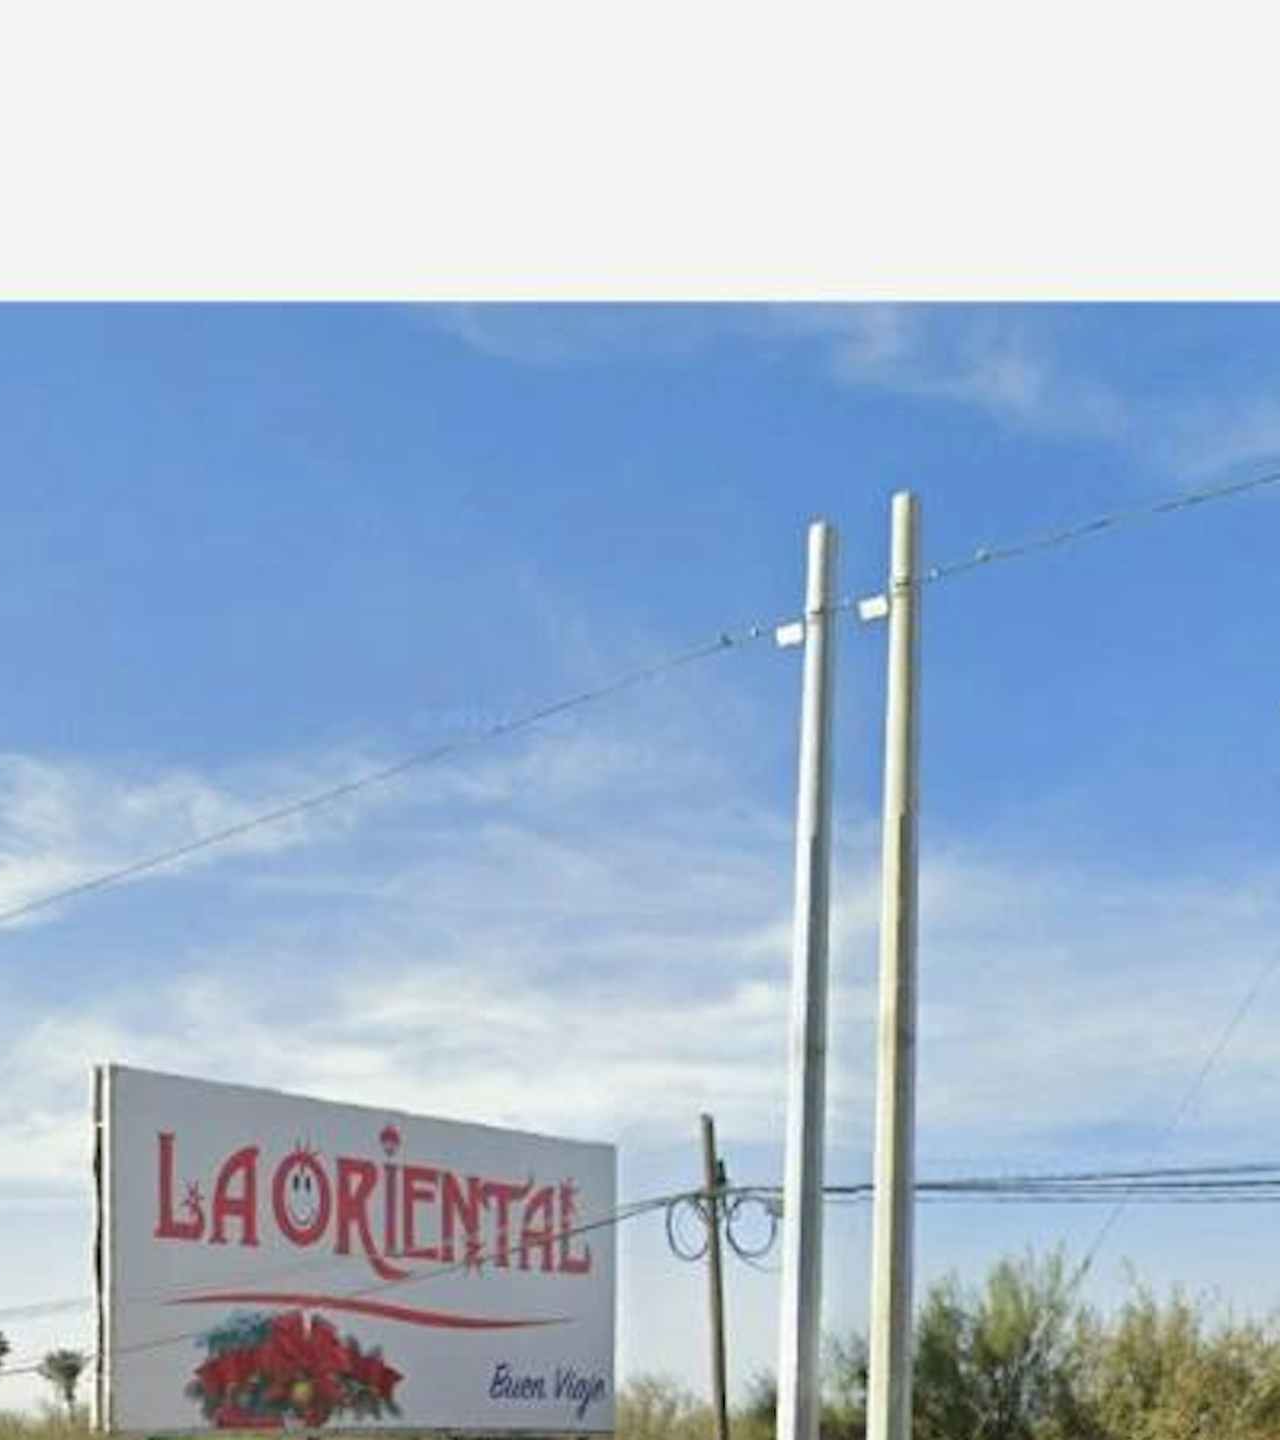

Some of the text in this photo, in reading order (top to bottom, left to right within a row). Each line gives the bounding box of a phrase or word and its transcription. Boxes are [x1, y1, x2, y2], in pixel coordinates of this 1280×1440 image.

[154, 1124, 592, 1281] LA ORIENTAL
[488, 1361, 547, 1400] Buen
